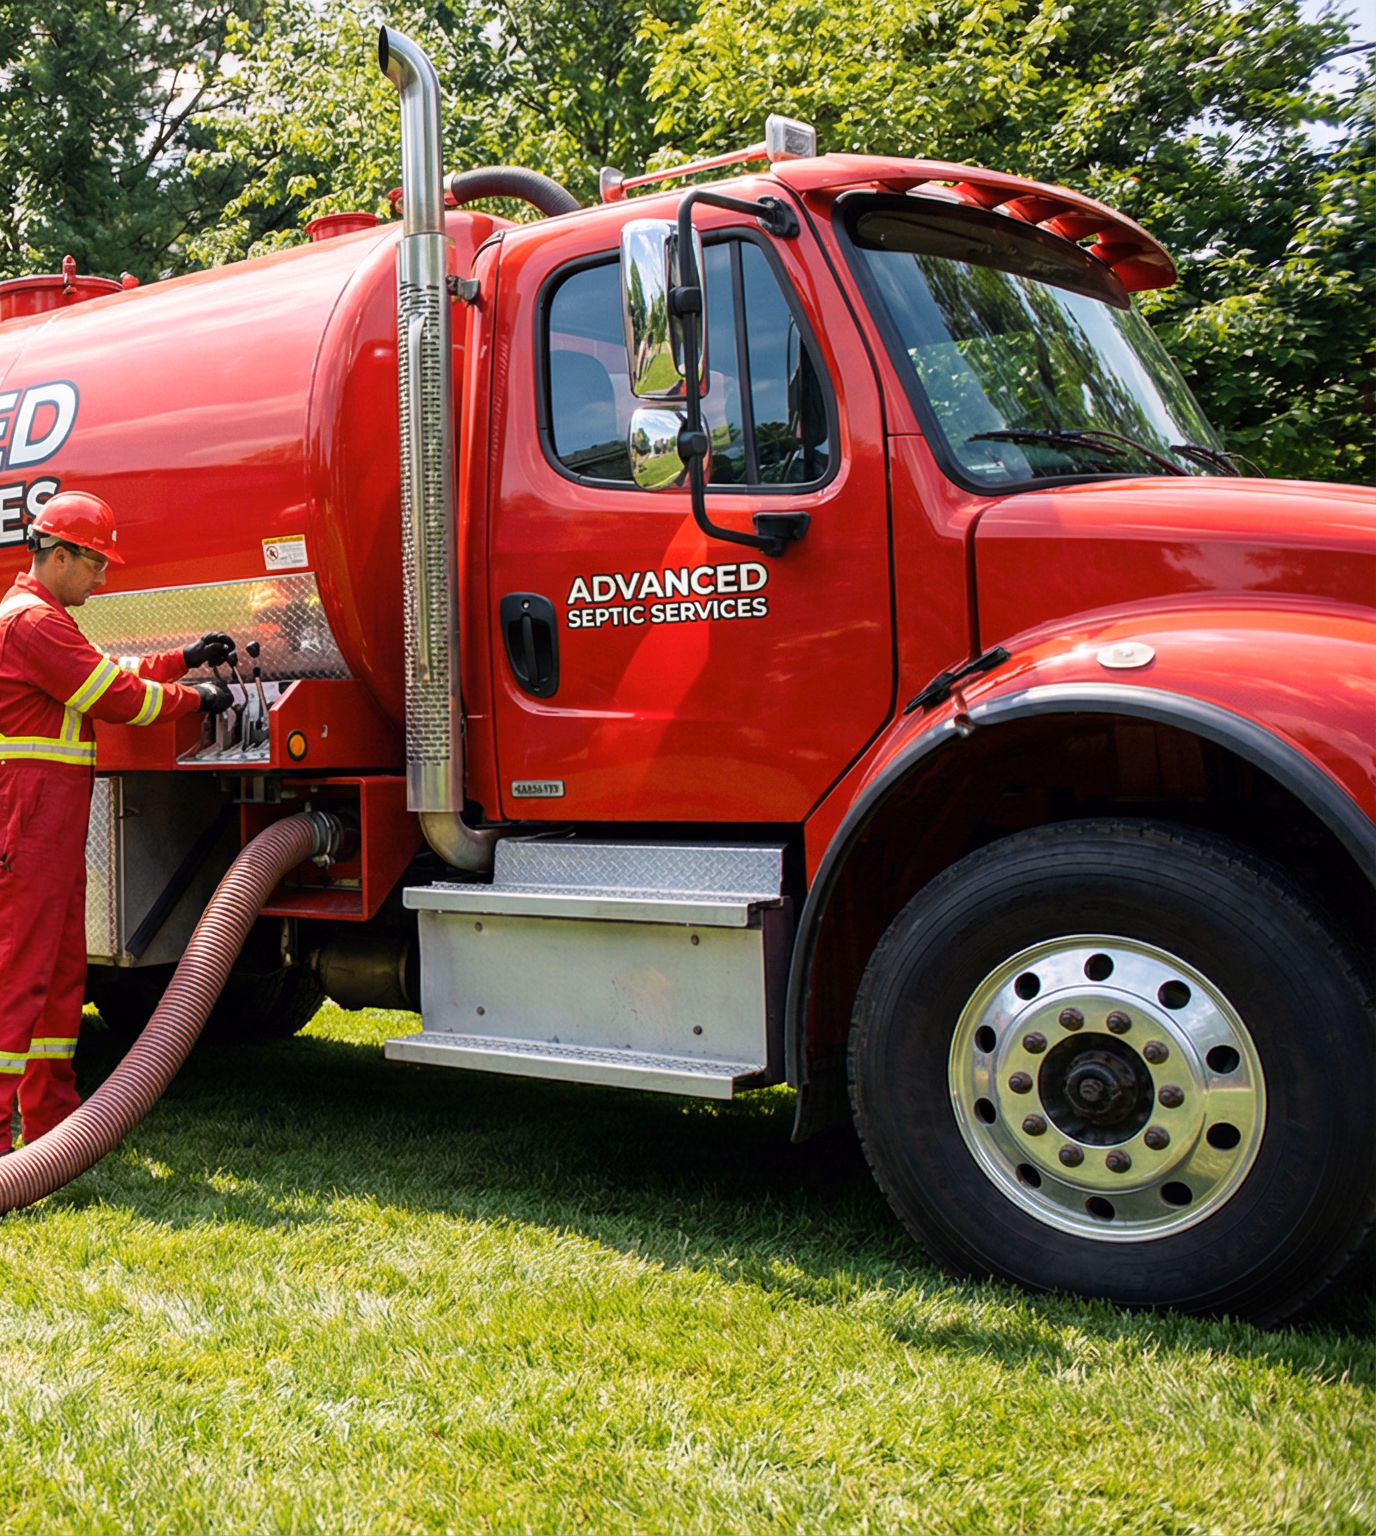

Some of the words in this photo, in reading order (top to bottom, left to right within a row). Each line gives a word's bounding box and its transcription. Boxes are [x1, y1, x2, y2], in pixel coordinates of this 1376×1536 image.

[566, 562, 768, 605] ADVANCED
[567, 606, 646, 629] SEPTIC
[649, 597, 768, 623] SERVICES
